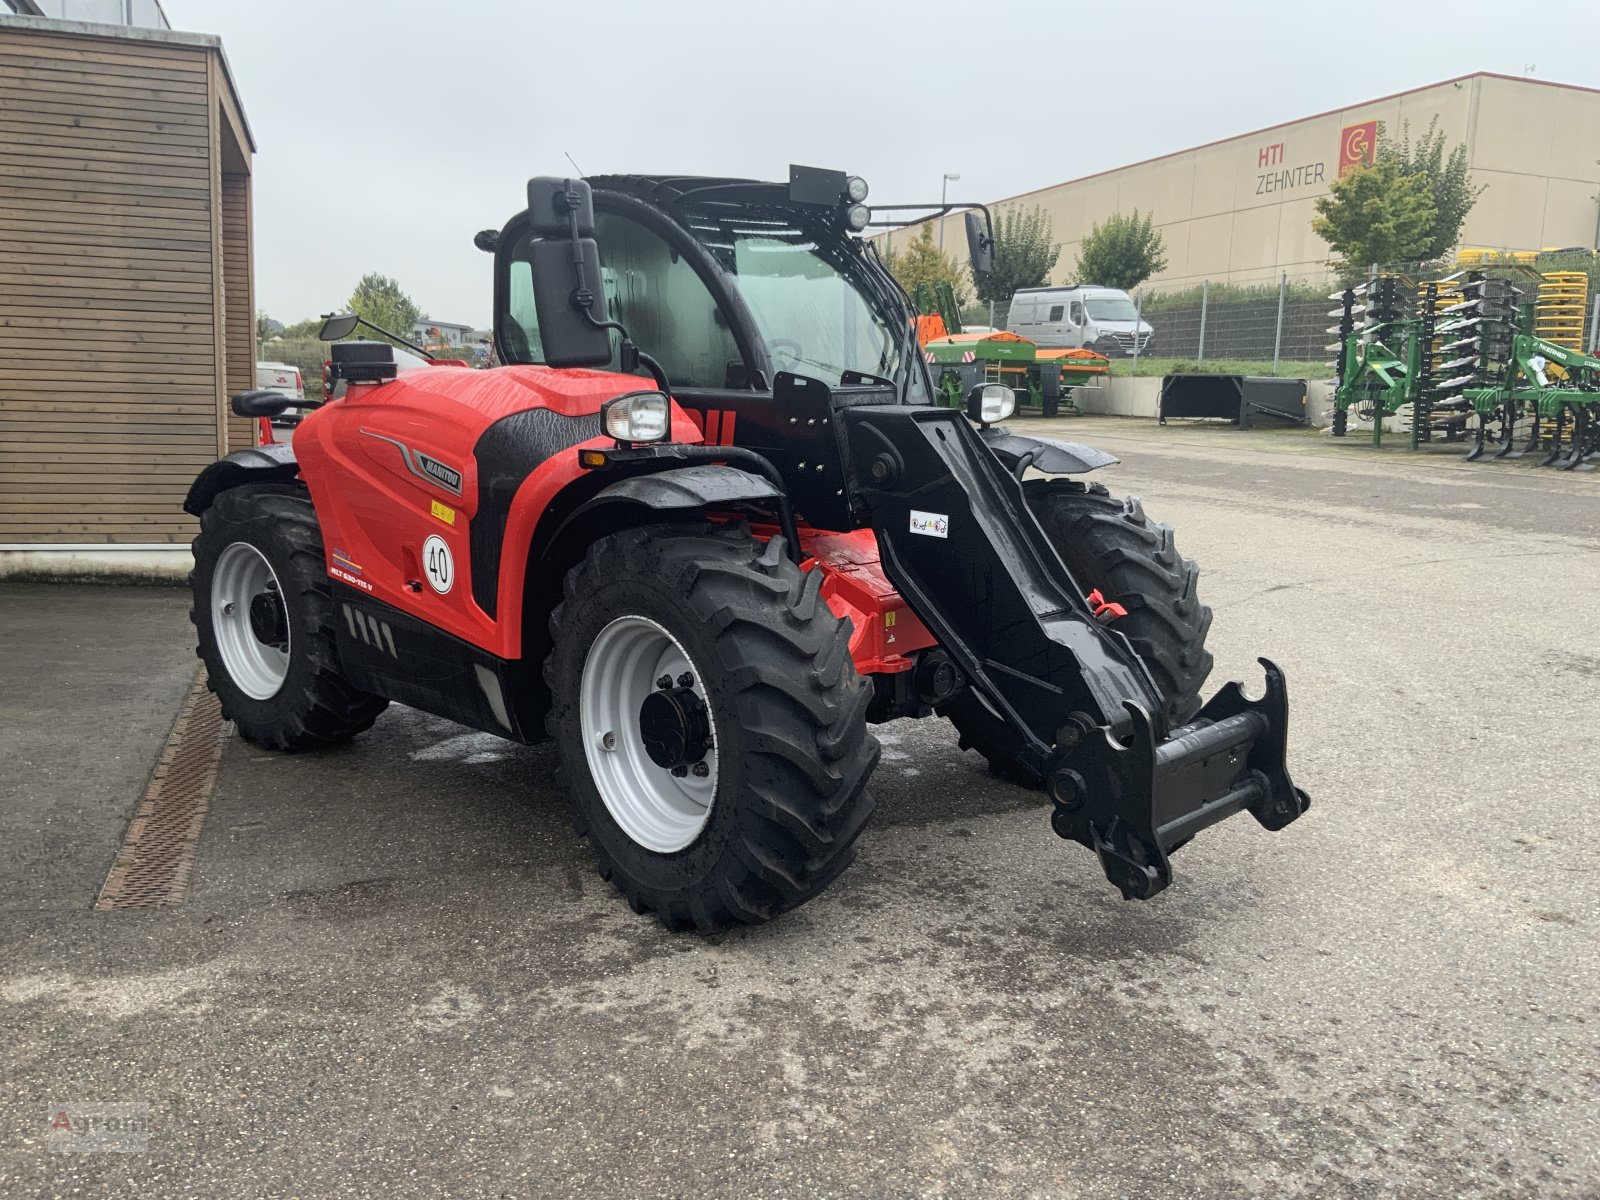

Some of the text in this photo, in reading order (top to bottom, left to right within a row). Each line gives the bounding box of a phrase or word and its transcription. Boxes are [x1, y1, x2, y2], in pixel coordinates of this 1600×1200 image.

[1258, 142, 1284, 168] HTI
[1256, 162, 1325, 195] ZEHNTER
[425, 459, 459, 486] MANITOU
[429, 546, 448, 584] 40
